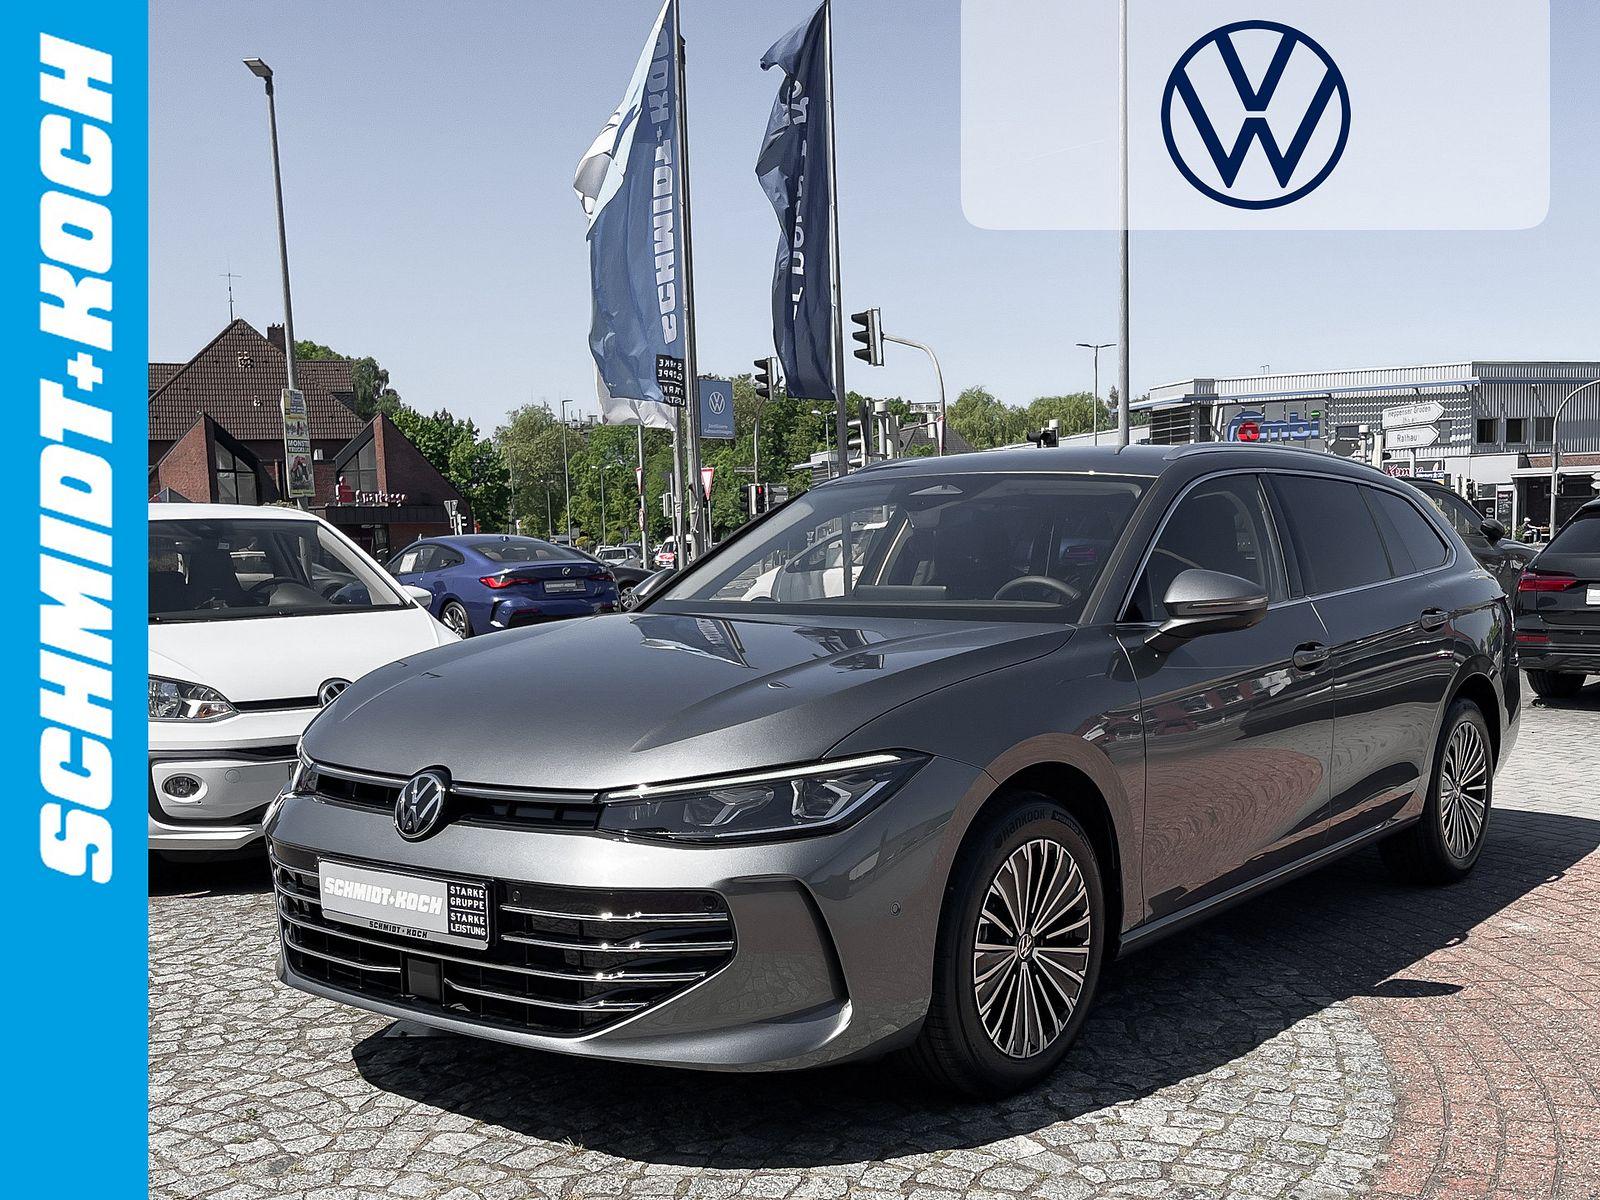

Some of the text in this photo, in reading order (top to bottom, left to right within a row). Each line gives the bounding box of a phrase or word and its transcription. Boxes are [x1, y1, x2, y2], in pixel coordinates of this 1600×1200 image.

[450, 885, 485, 899] STARKE
[450, 896, 485, 910] GRUPPE
[450, 912, 486, 926] STARKE
[368, 920, 401, 934] SCHMIDT
[406, 928, 428, 939] KOCH
[450, 922, 486, 936] LEISTUNG
